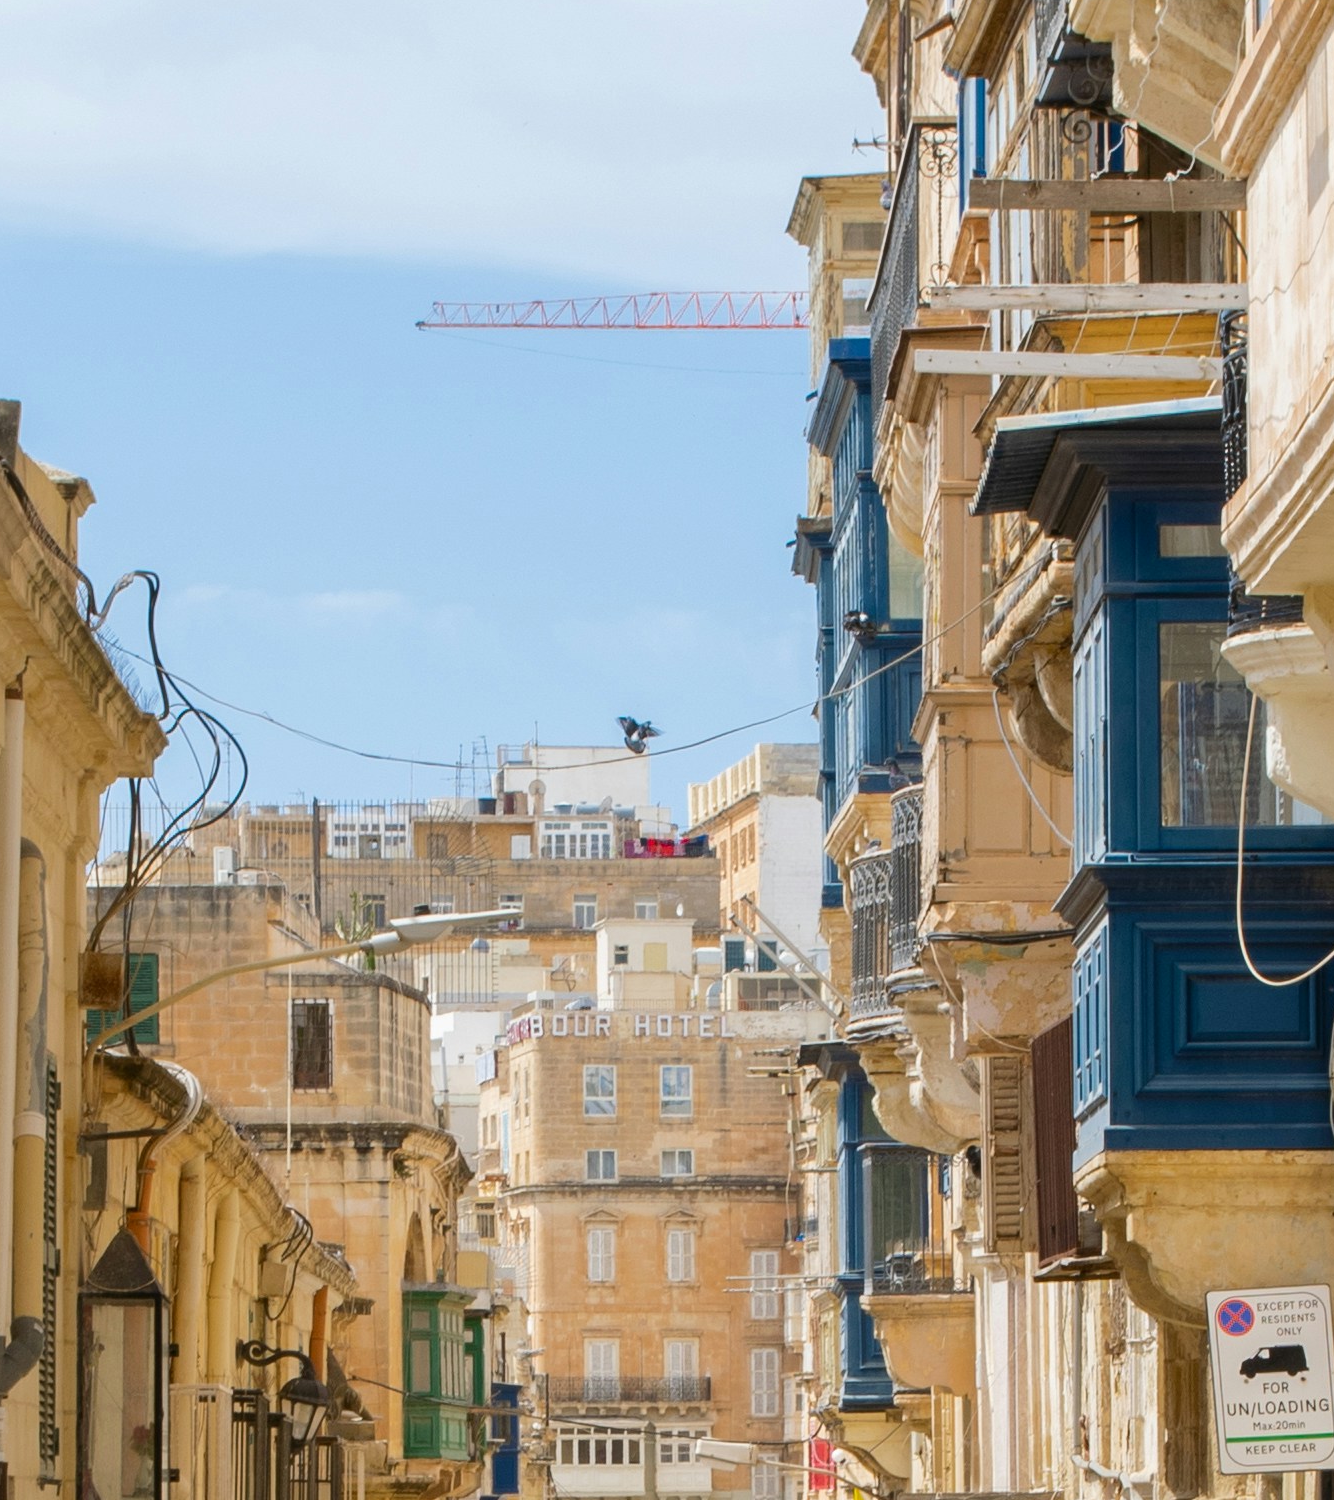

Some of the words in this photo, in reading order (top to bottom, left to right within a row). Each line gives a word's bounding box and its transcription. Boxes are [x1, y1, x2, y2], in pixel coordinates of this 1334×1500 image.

[634, 1014, 736, 1038] HOTEL
[1256, 1300, 1295, 1312] EXCEPT
[1298, 1299, 1319, 1310] FOR
[1261, 1312, 1316, 1324] RESIDENTS
[1276, 1326, 1303, 1337] ONLY
[1262, 1381, 1289, 1394] FOR
[1226, 1398, 1330, 1418] UN/LOADING
[1245, 1444, 1275, 1455] KEEP
[1279, 1443, 1317, 1454] CLEAR
